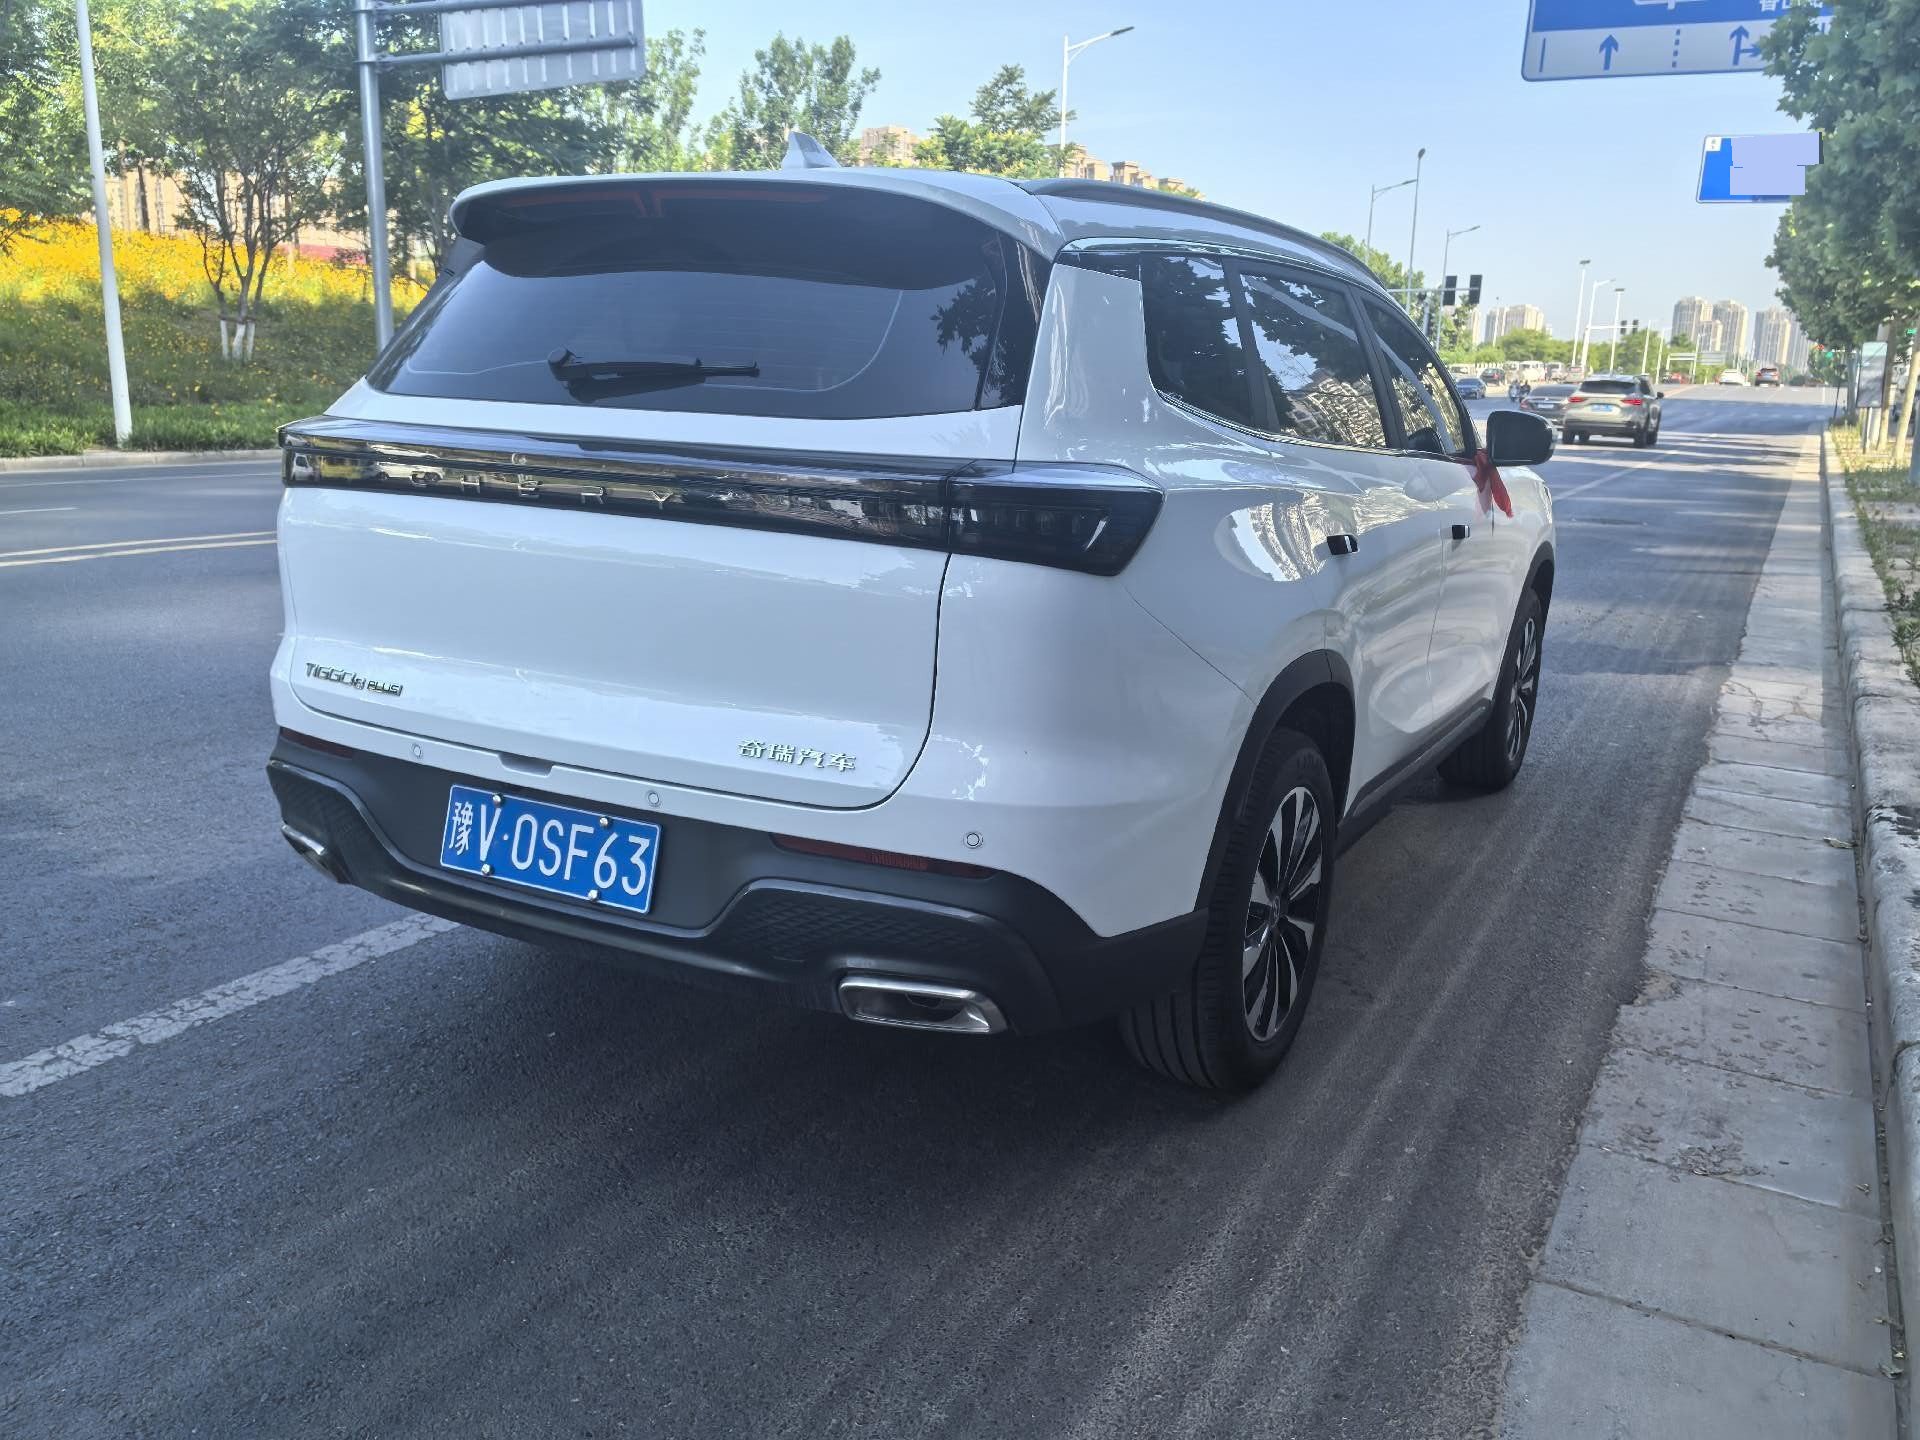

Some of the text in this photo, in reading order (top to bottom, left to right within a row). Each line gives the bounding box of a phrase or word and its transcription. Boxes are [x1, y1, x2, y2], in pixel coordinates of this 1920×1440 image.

[408, 471, 674, 510] CHERY
[367, 680, 403, 696] PLUS
[739, 739, 856, 772] 奇瑞汽车
